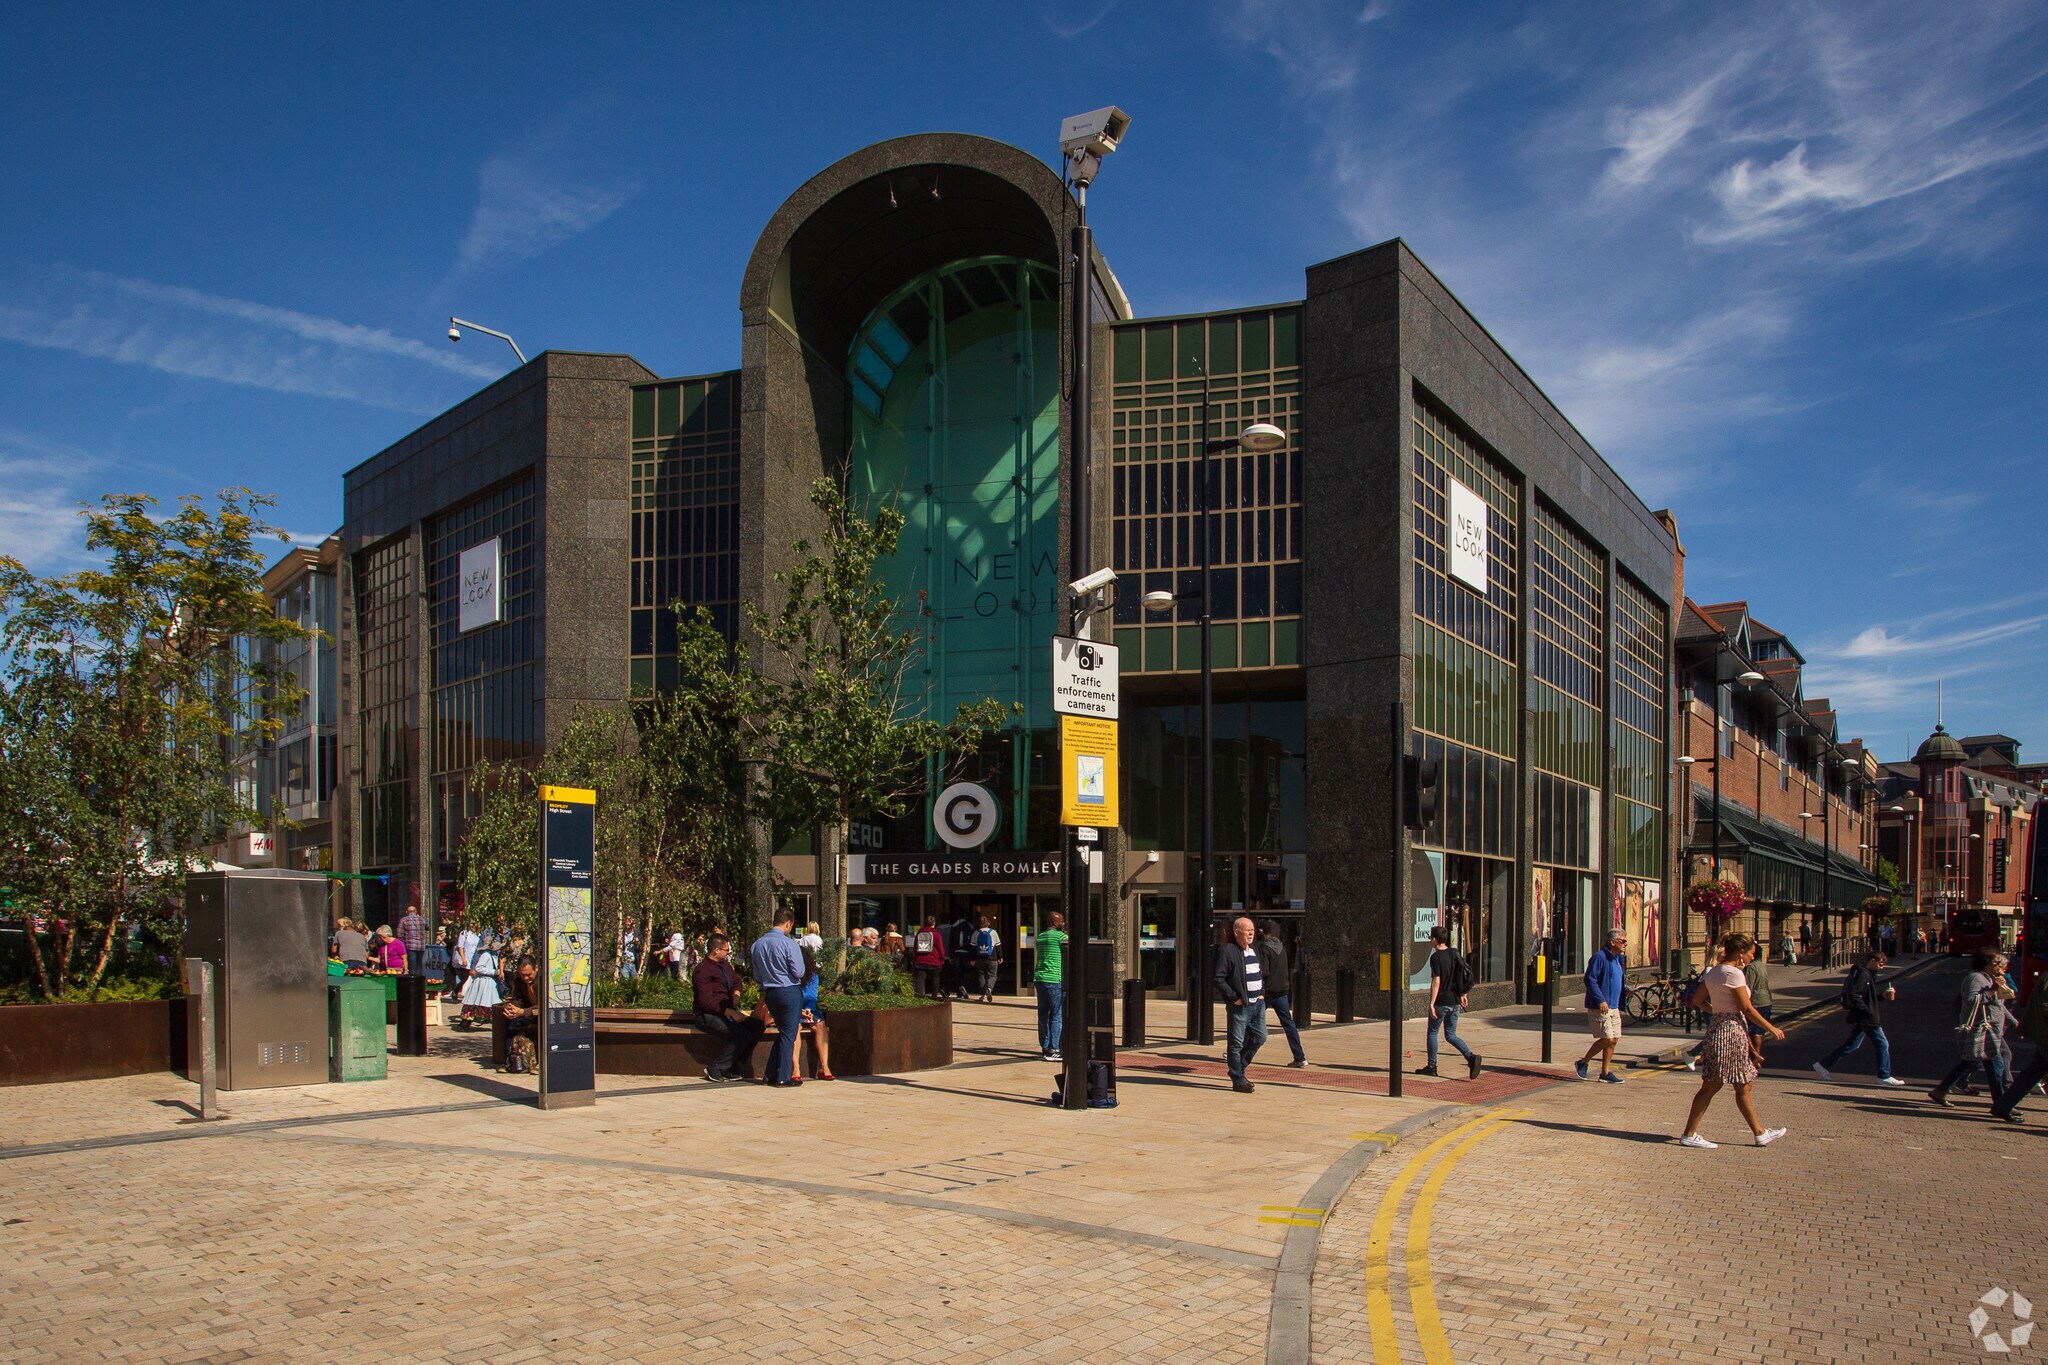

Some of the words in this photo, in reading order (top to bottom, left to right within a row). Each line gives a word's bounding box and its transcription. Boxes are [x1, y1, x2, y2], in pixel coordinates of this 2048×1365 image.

[1458, 514, 1482, 540] NEW
[1456, 532, 1484, 562] LOOK
[464, 567, 490, 588] NEW
[462, 583, 492, 606] LOOK
[1071, 674, 1102, 688] Traffic
[1058, 686, 1116, 702] enforcement
[1068, 700, 1106, 712] cameras
[871, 863, 900, 875] THE
[908, 863, 972, 875] GLADES
[982, 861, 1062, 874] BROMLEY
[1418, 910, 1436, 925] Lovely
